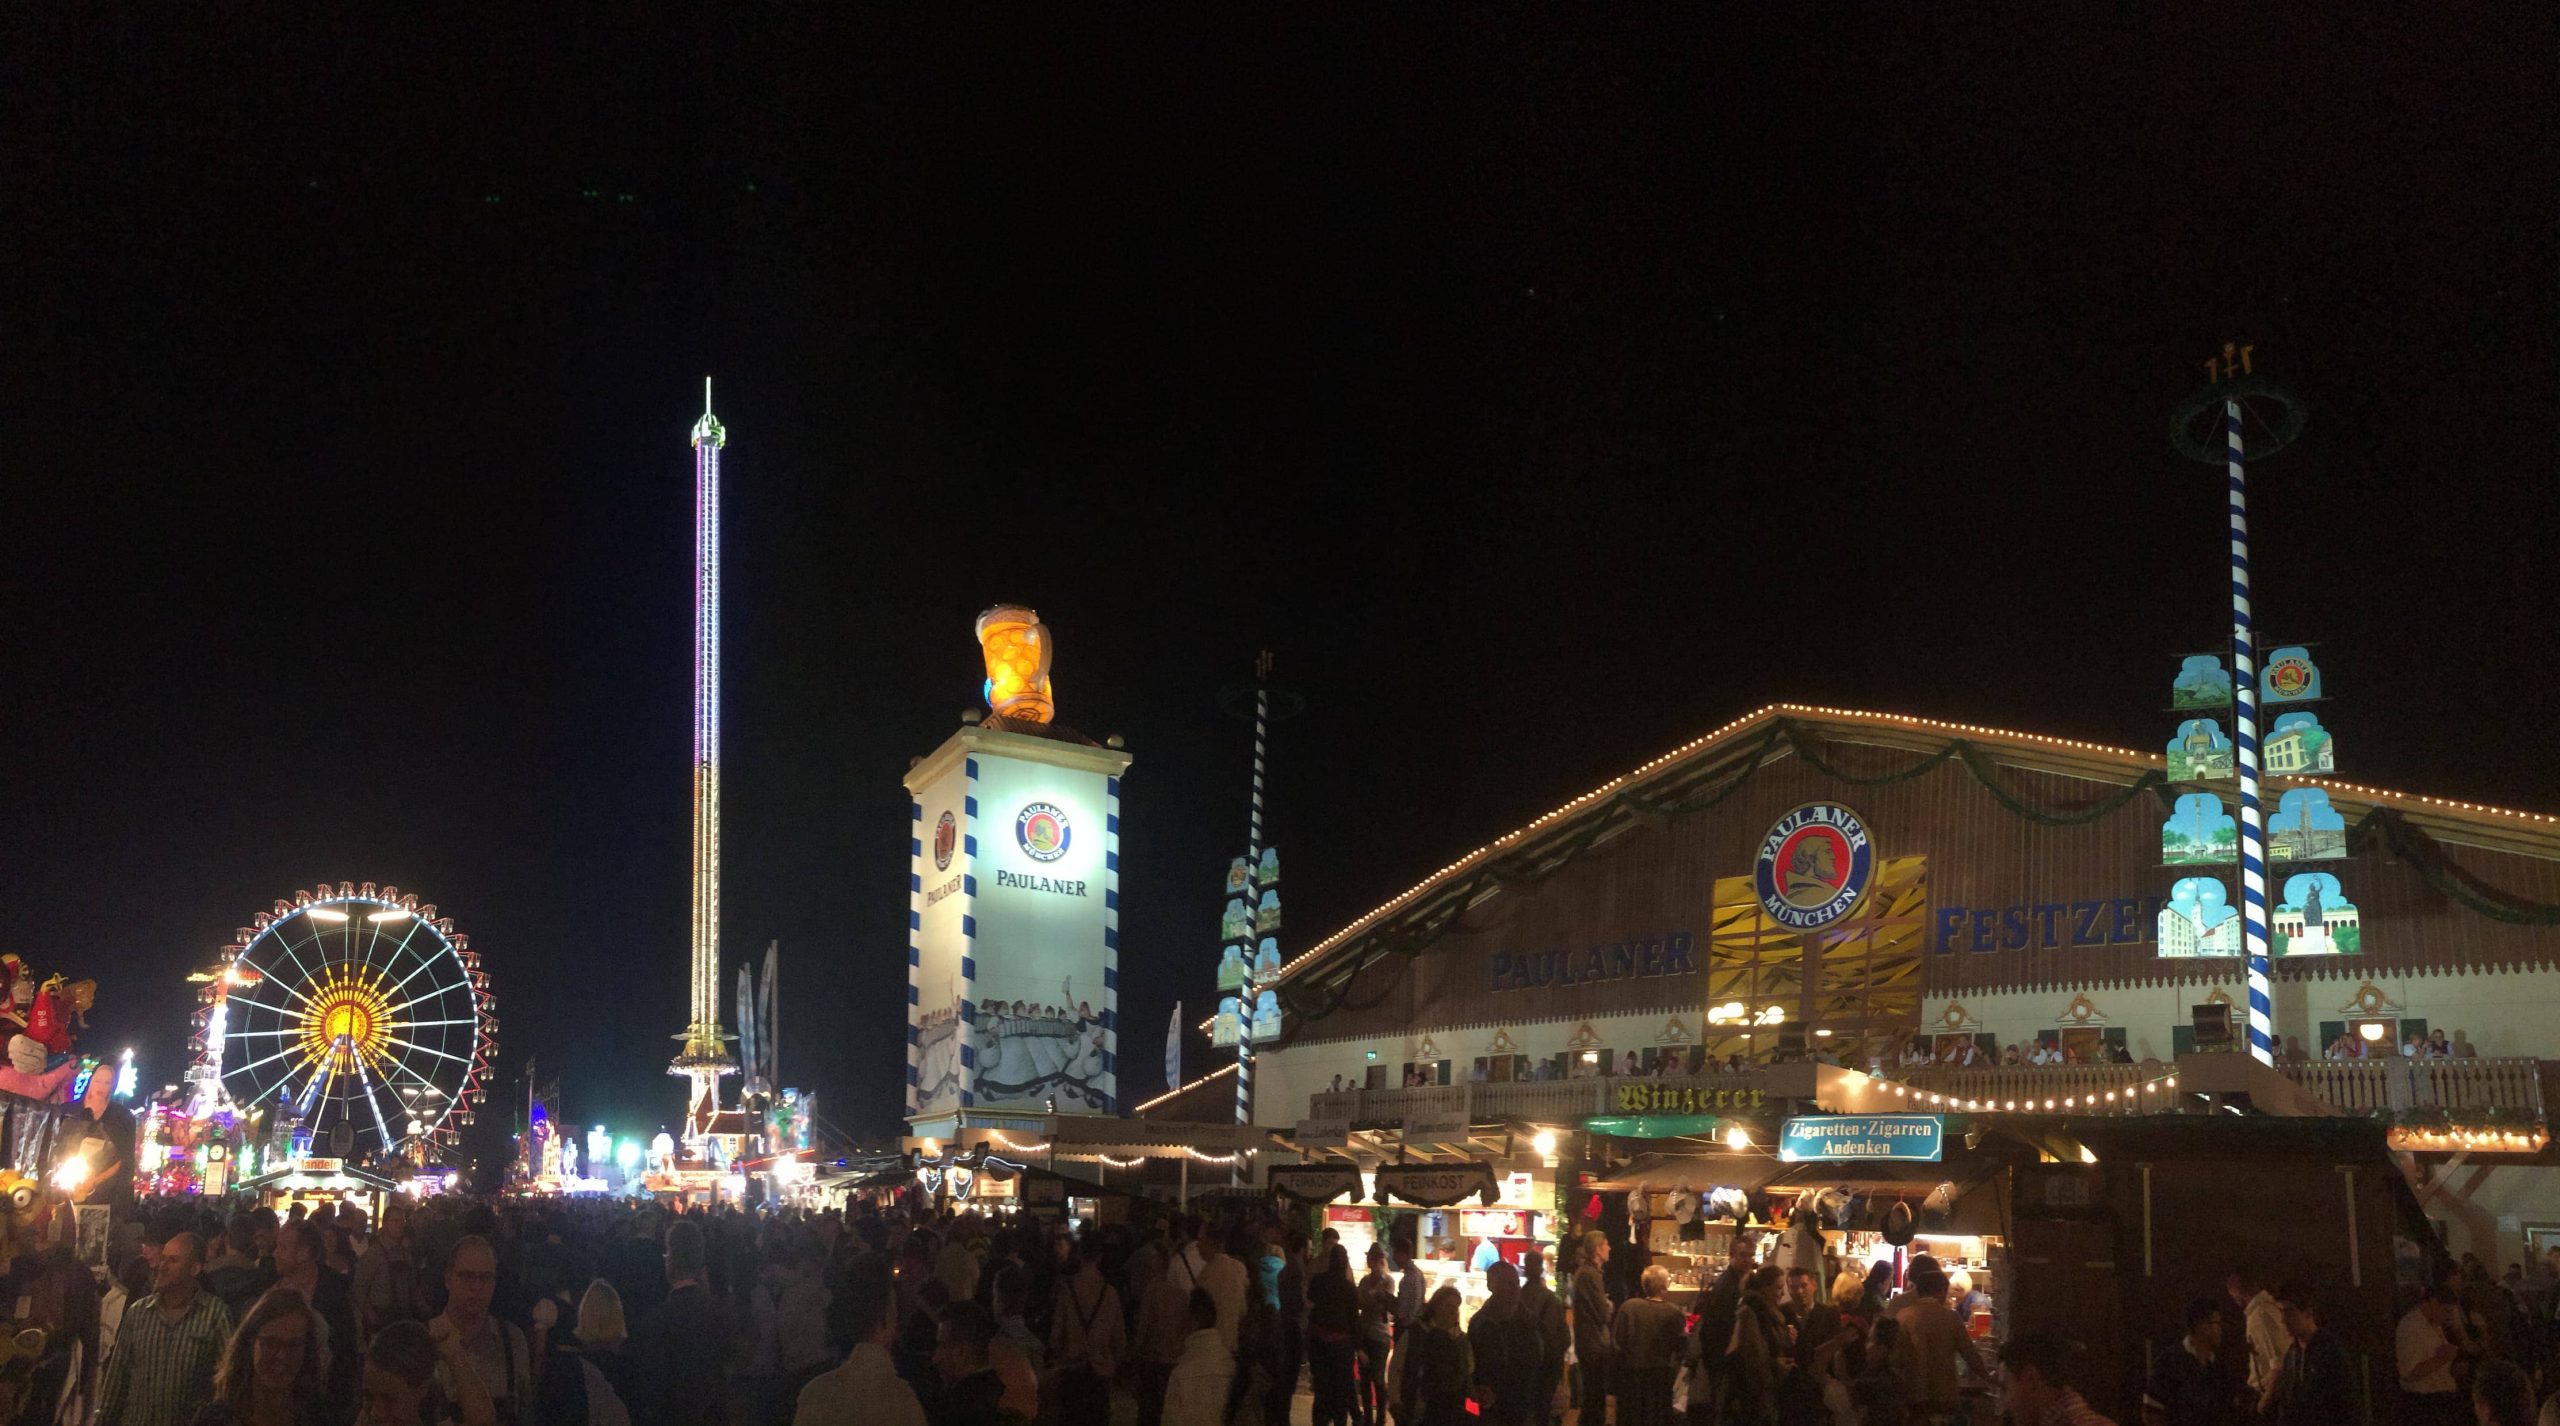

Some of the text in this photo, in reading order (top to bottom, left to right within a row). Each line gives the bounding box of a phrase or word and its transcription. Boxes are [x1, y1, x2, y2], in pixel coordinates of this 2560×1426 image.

[1019, 804, 1068, 828] PAULANER
[1761, 806, 1867, 862] PAULANER
[996, 869, 1088, 897] PAULANER
[1765, 886, 1858, 926] MÜNCHEN
[1490, 930, 1697, 994] PAULANER
[1617, 1080, 1766, 1114] Winzerer
[1789, 1120, 1932, 1139] Zigaretten Zigarren
[1821, 1139, 1891, 1155] Andenken
[1289, 1174, 1338, 1189] FEINKOST
[1403, 1175, 1465, 1191] FEINKOST
